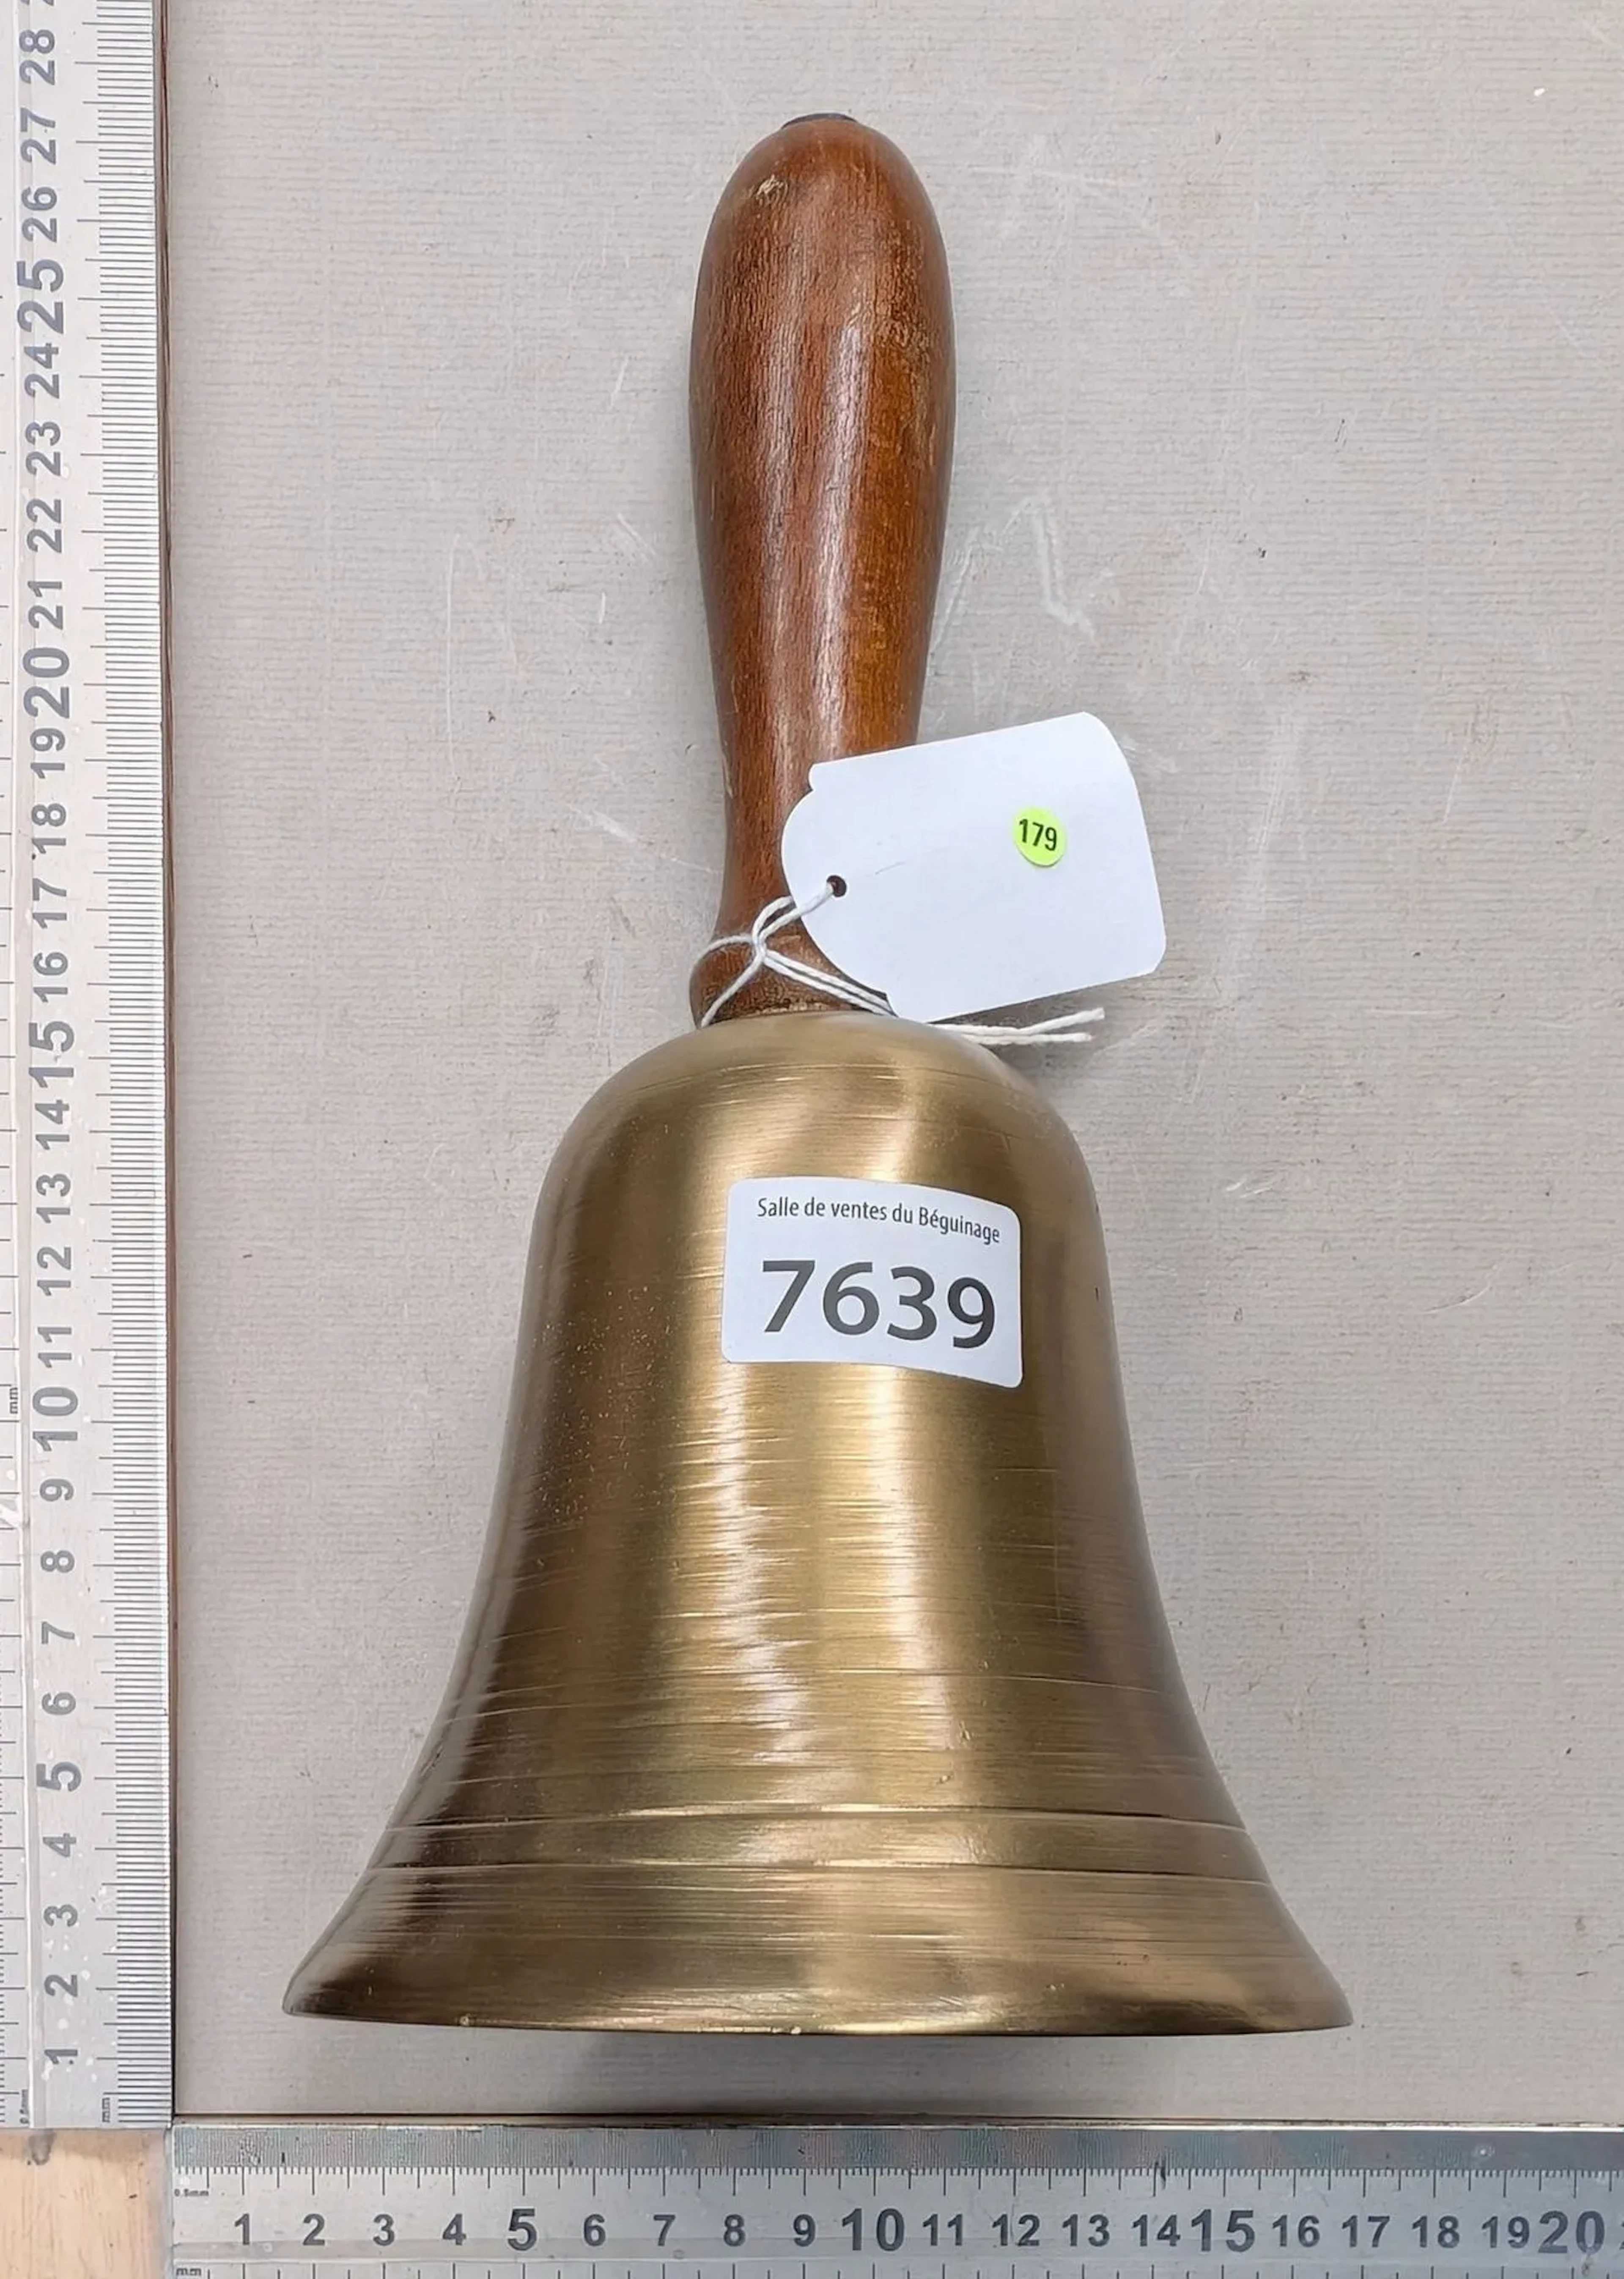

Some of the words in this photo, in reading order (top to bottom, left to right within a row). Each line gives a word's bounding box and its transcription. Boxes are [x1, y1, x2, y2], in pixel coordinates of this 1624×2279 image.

[19, 30, 55, 85] 28
[20, 107, 56, 165] 27
[21, 187, 57, 243] 26
[16, 260, 63, 334] 25
[24, 343, 59, 399] 24
[25, 422, 60, 476] 23
[26, 499, 62, 553] 22
[27, 581, 63, 630] 21
[22, 648, 69, 719] 20
[30, 729, 65, 779] 19
[31, 804, 66, 854] 18
[1019, 818, 1057, 851] 179
[32, 878, 67, 929] 17
[33, 952, 68, 1002] 16
[28, 1022, 74, 1088] 15
[35, 1100, 70, 1150] 14
[36, 1174, 71, 1223] 13
[758, 1197, 798, 1216] Salle
[805, 1197, 825, 1216] de
[831, 1202, 886, 1220] ventes
[893, 1204, 912, 1223] du
[919, 1207, 999, 1245] Béguinage
[37, 1247, 71, 1296] 12
[763, 1261, 995, 1349] 7639
[38, 1327, 72, 1368] 11
[9, 1387, 18, 1414] mm
[33, 1388, 78, 1451] 10
[40, 1479, 74, 1502] 9
[41, 1550, 74, 1573] 8
[41, 1621, 75, 1644] 7
[42, 1692, 76, 1715] 6
[36, 1763, 80, 1791] 5
[43, 1833, 77, 1857] 4
[44, 1904, 78, 1927] 3
[44, 1975, 78, 1997] 2
[44, 2049, 78, 2065] 1
[102, 2097, 110, 2122] mm
[234, 2213, 250, 2246] 1
[302, 2213, 325, 2246] 2
[373, 2214, 395, 2246] 3
[442, 2213, 466, 2246] 4
[508, 2208, 537, 2251] 5
[584, 2214, 606, 2247] 6
[653, 2214, 675, 2246] 7
[723, 2214, 745, 2247] 8
[793, 2214, 815, 2247] 9
[842, 2208, 904, 2251] 10
[923, 2214, 963, 2246] 11
[992, 2214, 1040, 2247] 12
[1062, 2214, 1109, 2247] 13
[1132, 2215, 1180, 2247] 14
[1191, 2209, 1254, 2252] 15
[1273, 2215, 1320, 2247] 16
[1342, 2215, 1390, 2247] 17
[1412, 2216, 1459, 2248] 18
[1482, 2216, 1529, 2248] 19
[1539, 2211, 1604, 2253] 20
[176, 2268, 202, 2276] mm
